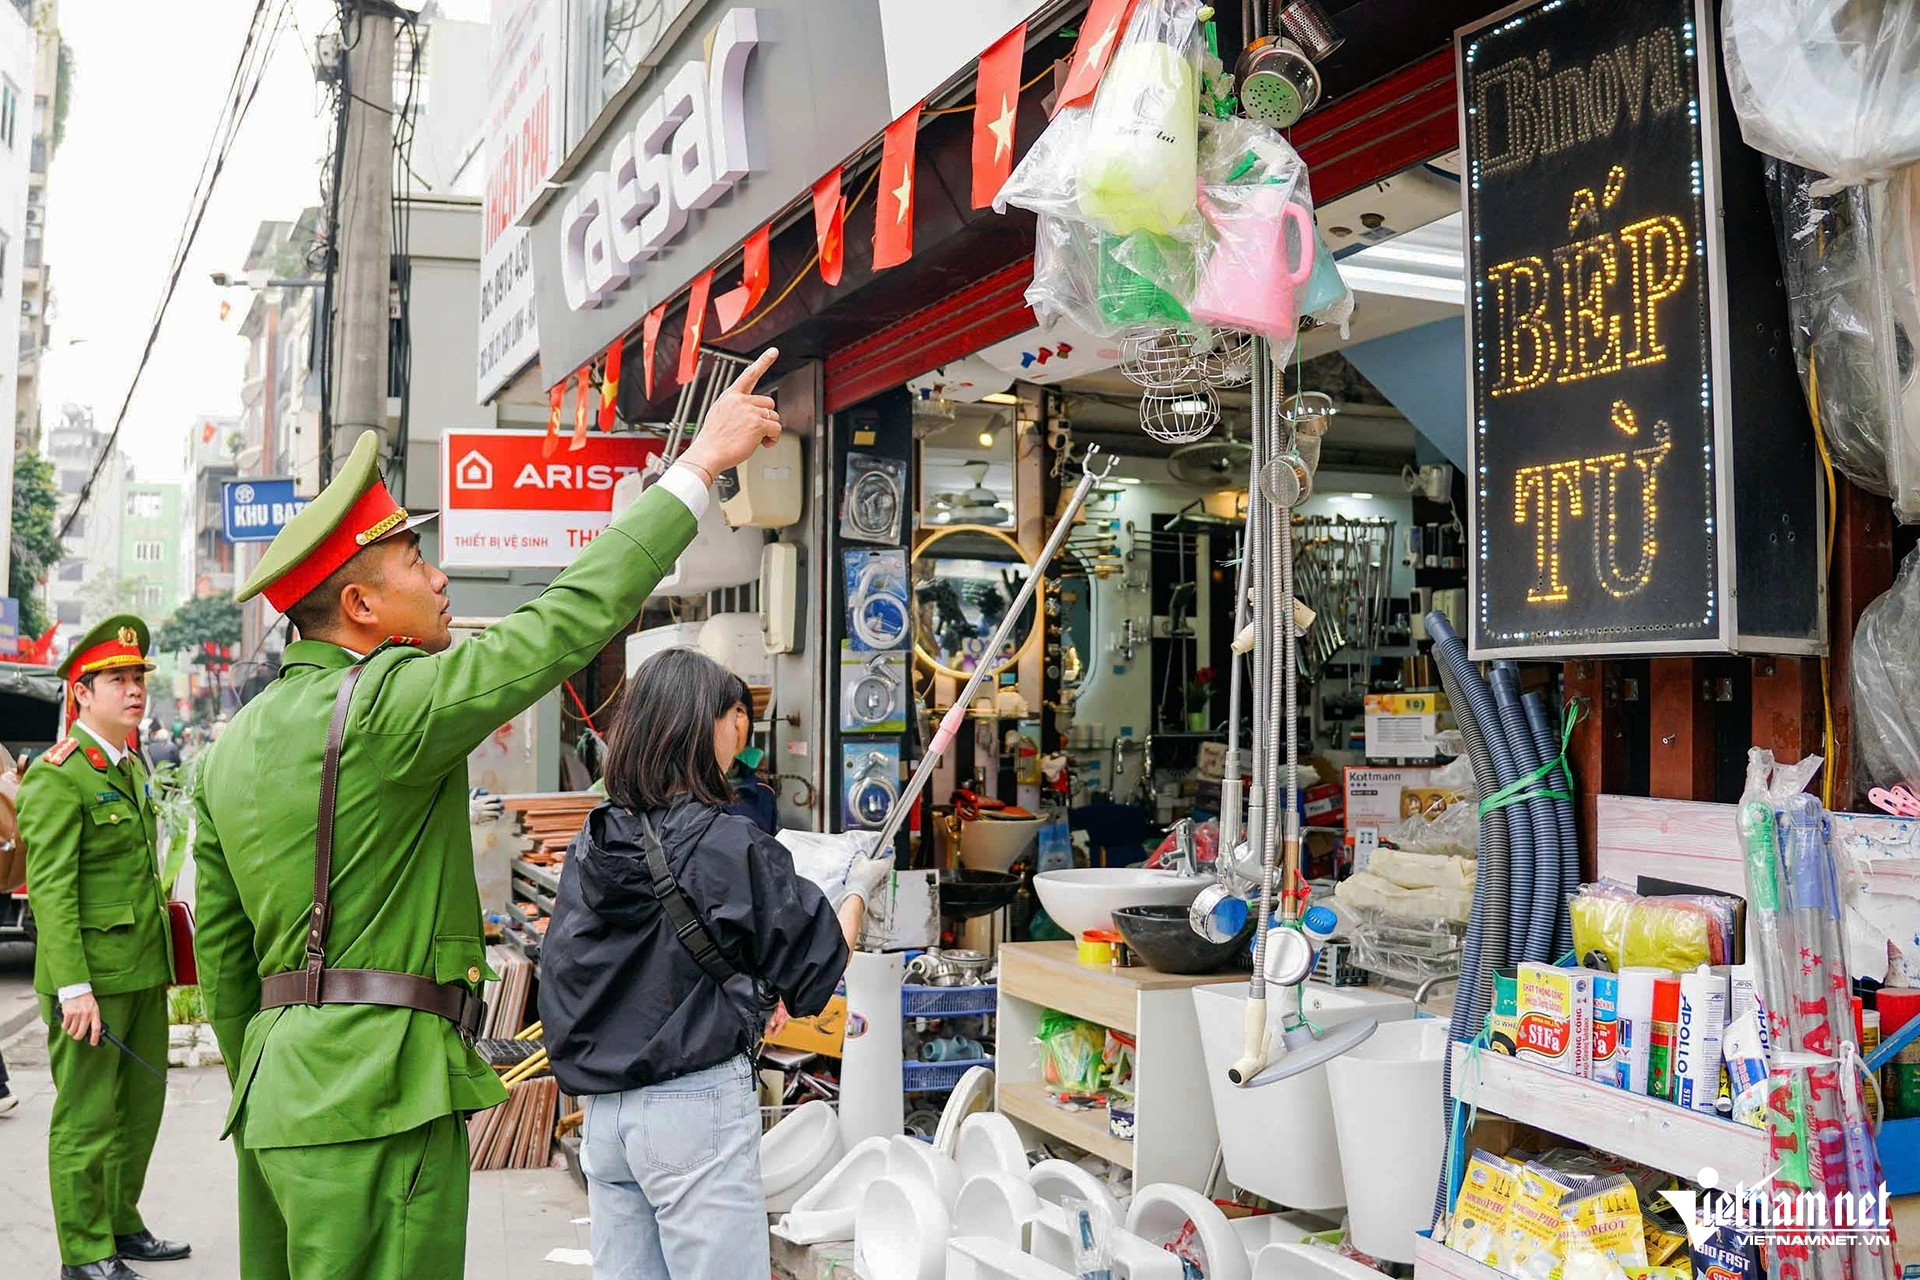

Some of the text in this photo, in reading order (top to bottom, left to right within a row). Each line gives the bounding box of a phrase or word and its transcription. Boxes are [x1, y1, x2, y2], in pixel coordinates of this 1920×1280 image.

[560, 7, 759, 312] caesar
[1487, 163, 1690, 396] BẾP
[234, 503, 269, 527] KHU
[1513, 399, 1671, 602] TỪ
[455, 533, 486, 547] THIẾT
[521, 536, 548, 547] SINH
[1349, 771, 1401, 782] Kottmann
[1678, 991, 1693, 1074] APOLLO
[1718, 1247, 1751, 1271] FAST
